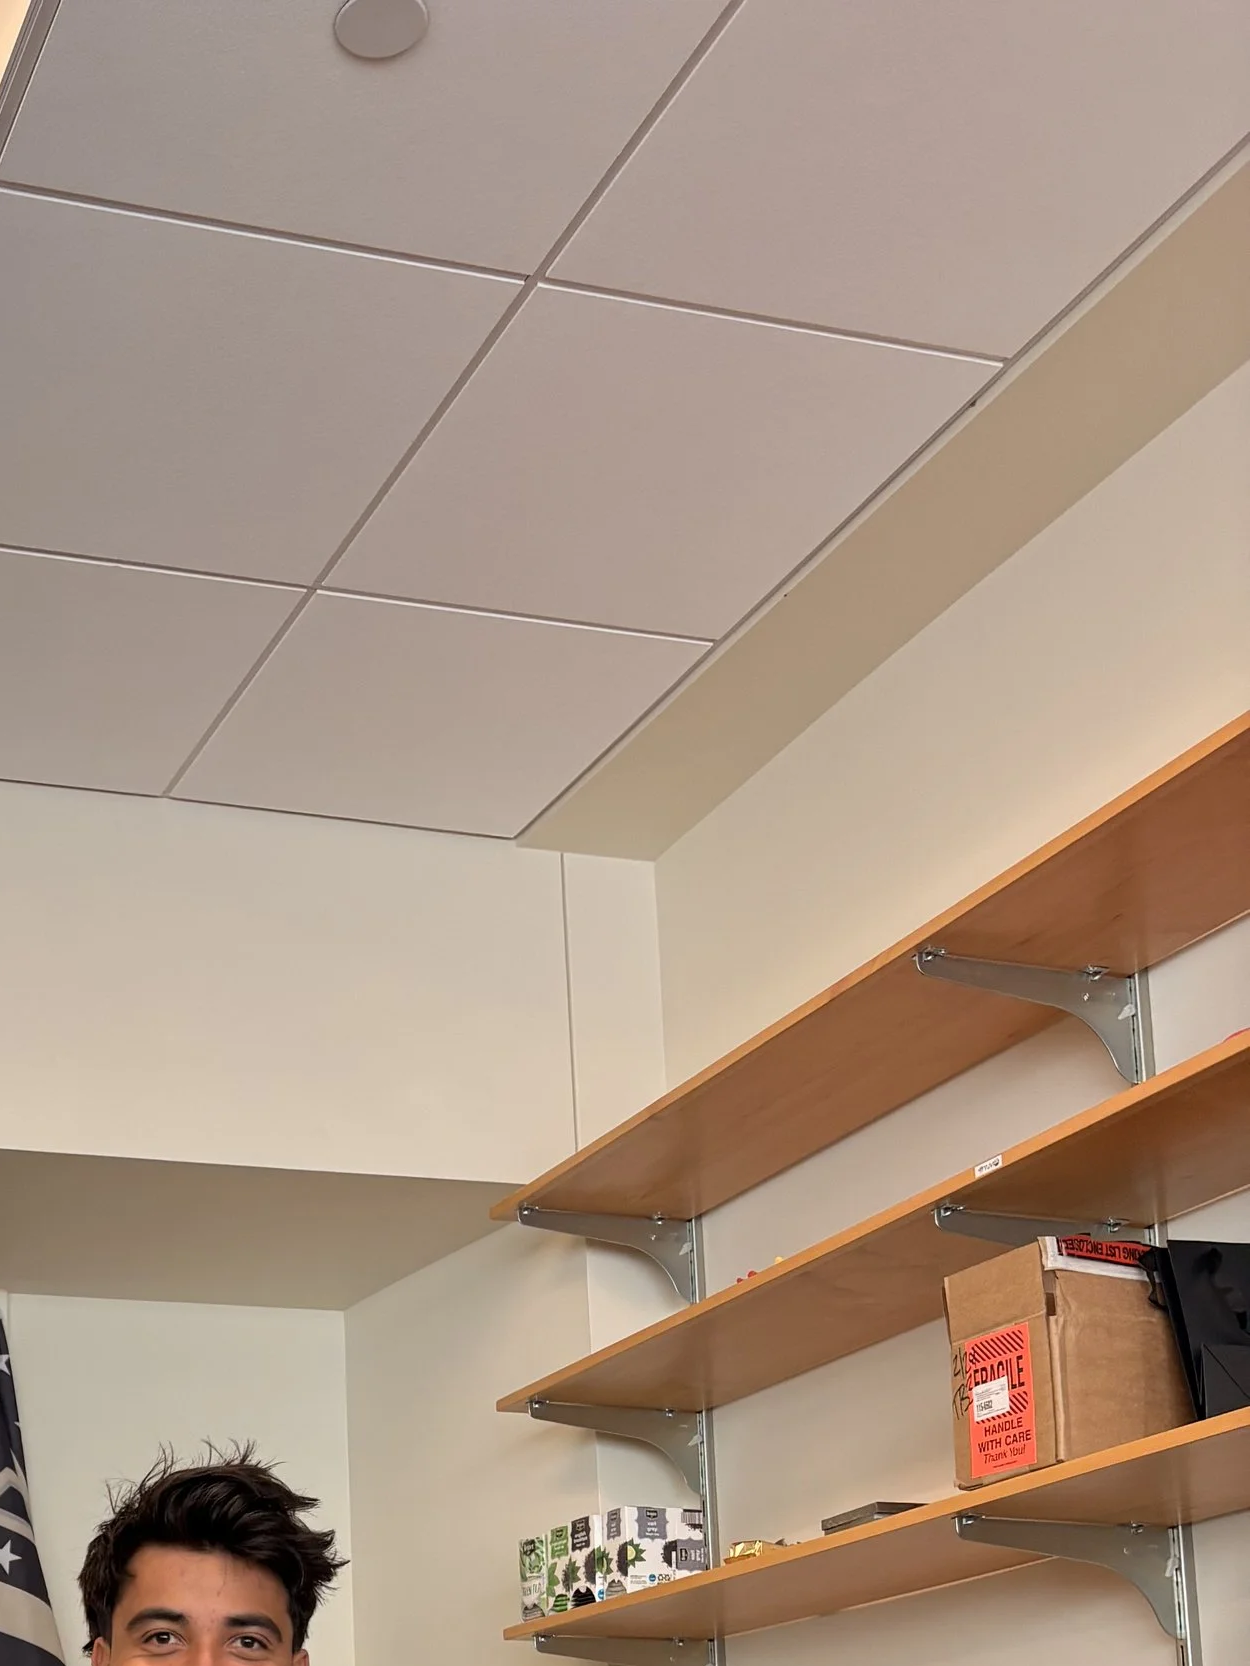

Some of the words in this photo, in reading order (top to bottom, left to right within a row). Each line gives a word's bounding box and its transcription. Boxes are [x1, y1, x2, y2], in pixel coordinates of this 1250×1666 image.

[1105, 1244, 1121, 1260] LIST
[973, 1355, 1025, 1392] FRAGILE
[984, 1416, 1023, 1437] HANDLE
[978, 1437, 1002, 1453] WITH
[1005, 1429, 1032, 1447] CARE
[984, 1449, 1008, 1464] Thank
